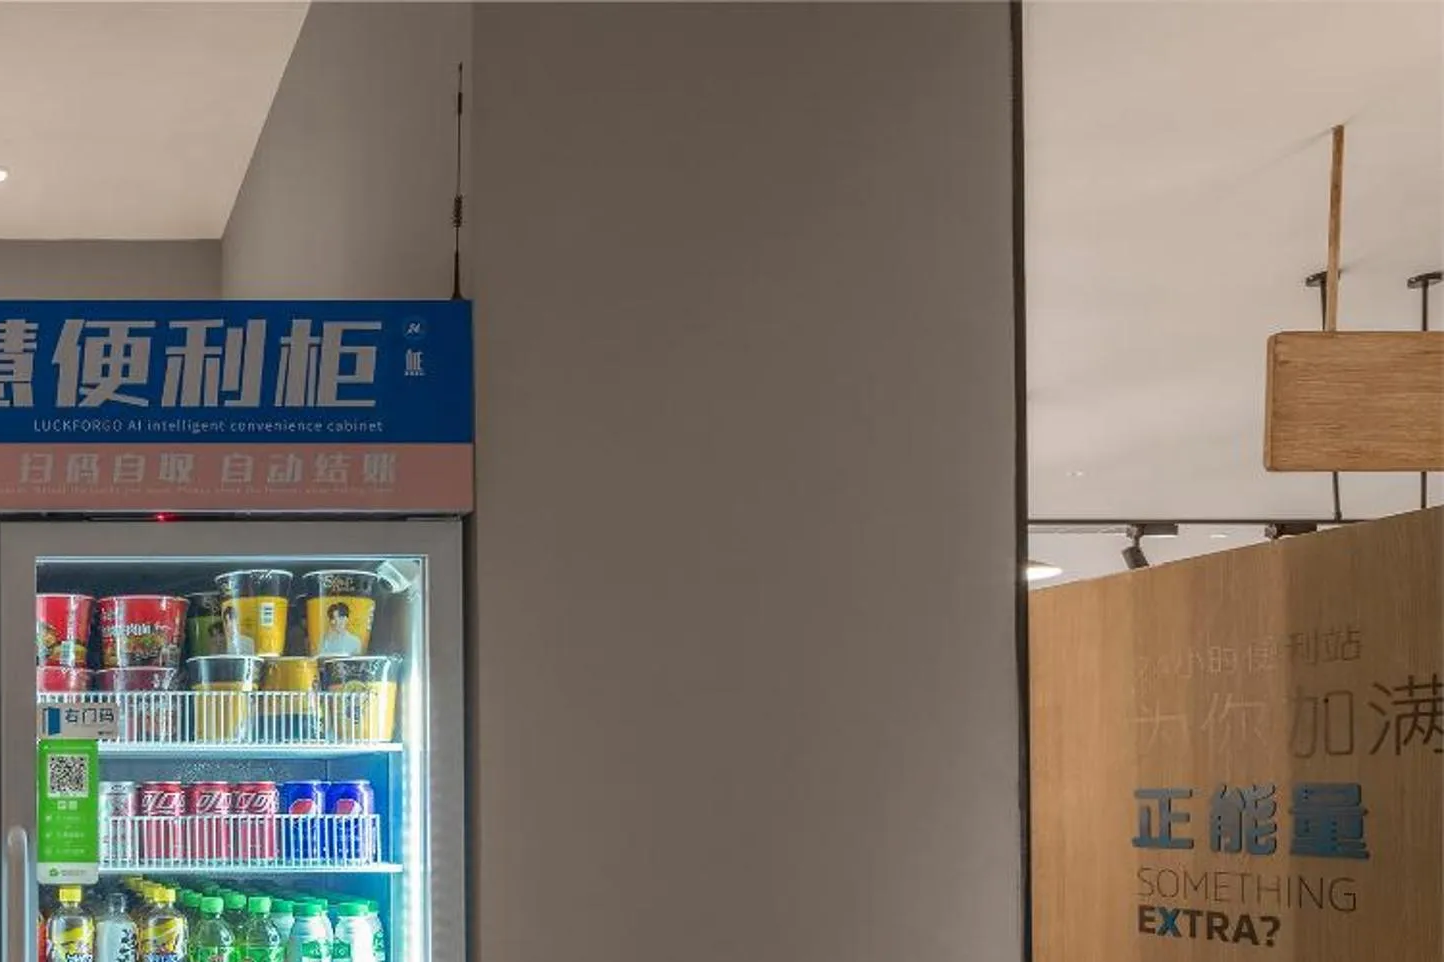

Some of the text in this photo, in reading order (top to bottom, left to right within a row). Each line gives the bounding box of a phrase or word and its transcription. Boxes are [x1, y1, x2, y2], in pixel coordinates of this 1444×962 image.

[33, 419, 123, 433] LUCKFORGO
[147, 418, 225, 435] intelligent
[230, 419, 323, 433] convenience
[327, 418, 384, 433] cabinet
[19, 453, 194, 485] 扫码自取
[64, 707, 115, 724] 右门码
[1131, 783, 1371, 861] 正能量
[1136, 866, 1357, 912] SOMETHING
[1138, 905, 1282, 948] EXTRA?
